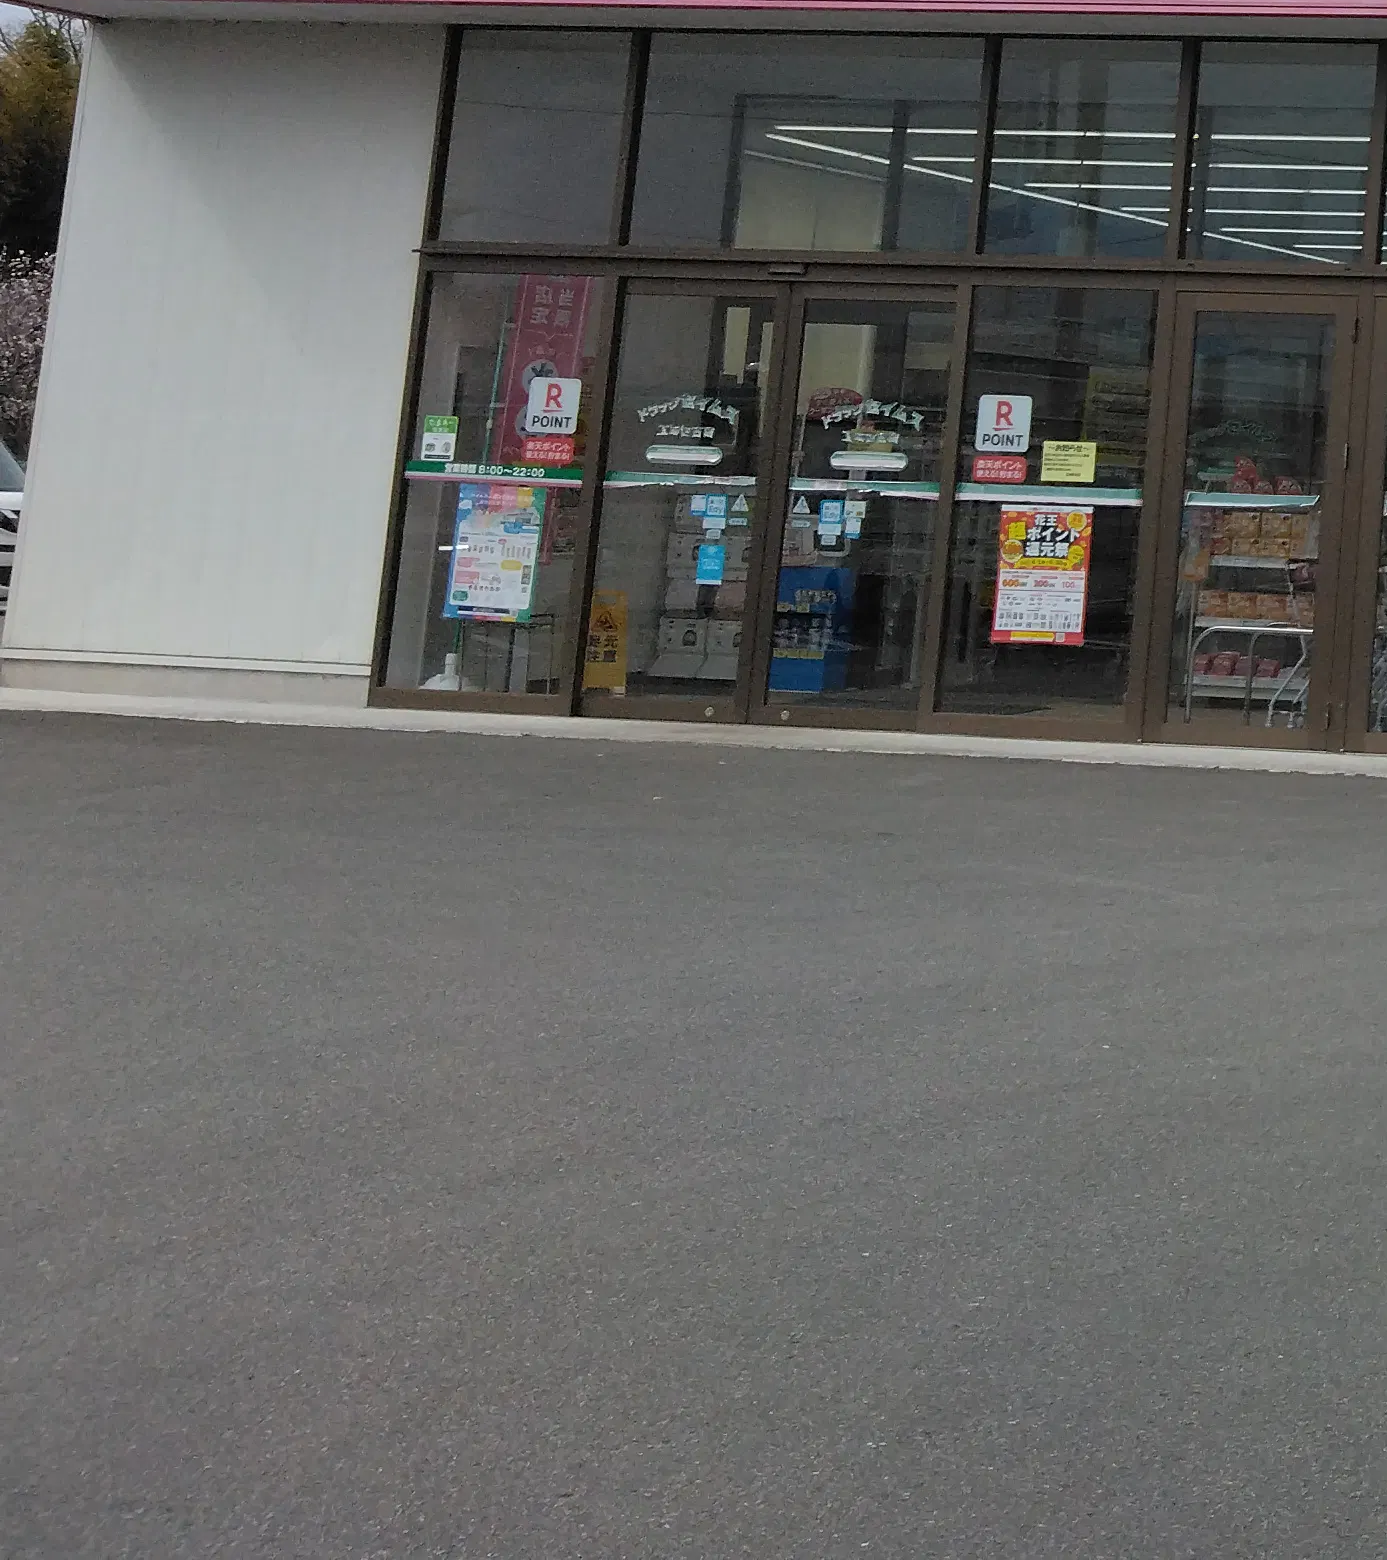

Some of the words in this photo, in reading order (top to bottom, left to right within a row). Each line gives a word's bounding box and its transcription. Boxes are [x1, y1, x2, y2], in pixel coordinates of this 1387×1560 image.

[544, 382, 563, 409] R
[996, 400, 1014, 427] R
[532, 415, 572, 428] POINT
[982, 433, 1024, 447] POINT
[1035, 514, 1058, 527] 花王
[1027, 526, 1080, 543] ポイント
